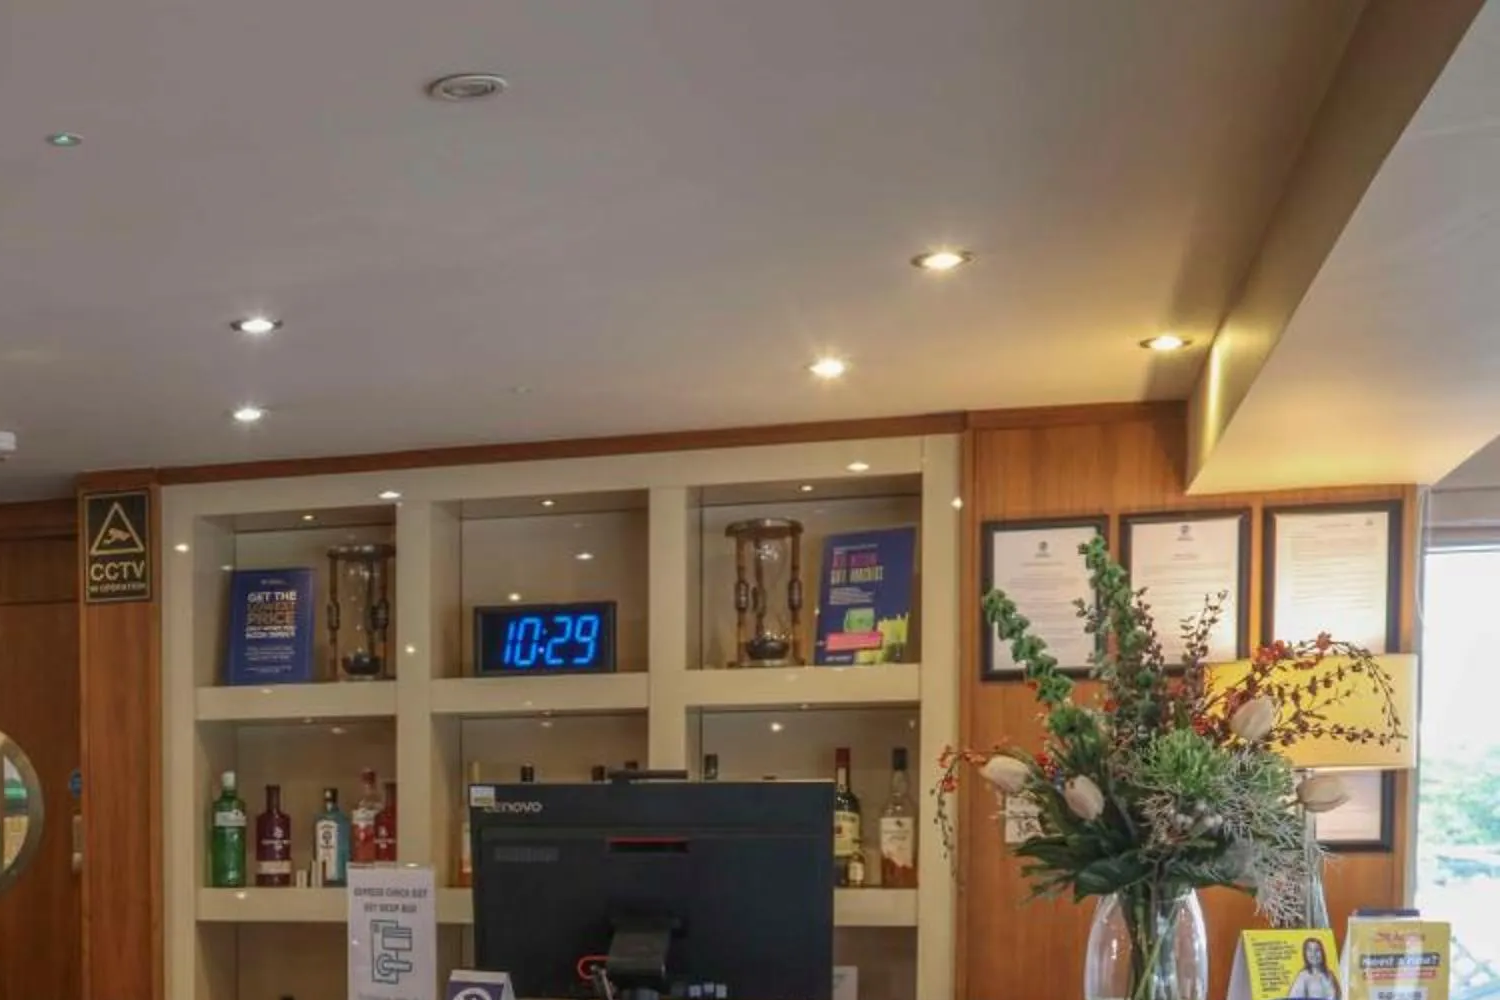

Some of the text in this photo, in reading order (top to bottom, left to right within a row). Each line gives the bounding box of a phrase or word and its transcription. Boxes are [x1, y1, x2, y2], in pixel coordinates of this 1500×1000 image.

[91, 560, 145, 581] CCTV
[274, 591, 297, 601] THE
[247, 611, 295, 625] PRICE
[503, 613, 599, 667] 10:29
